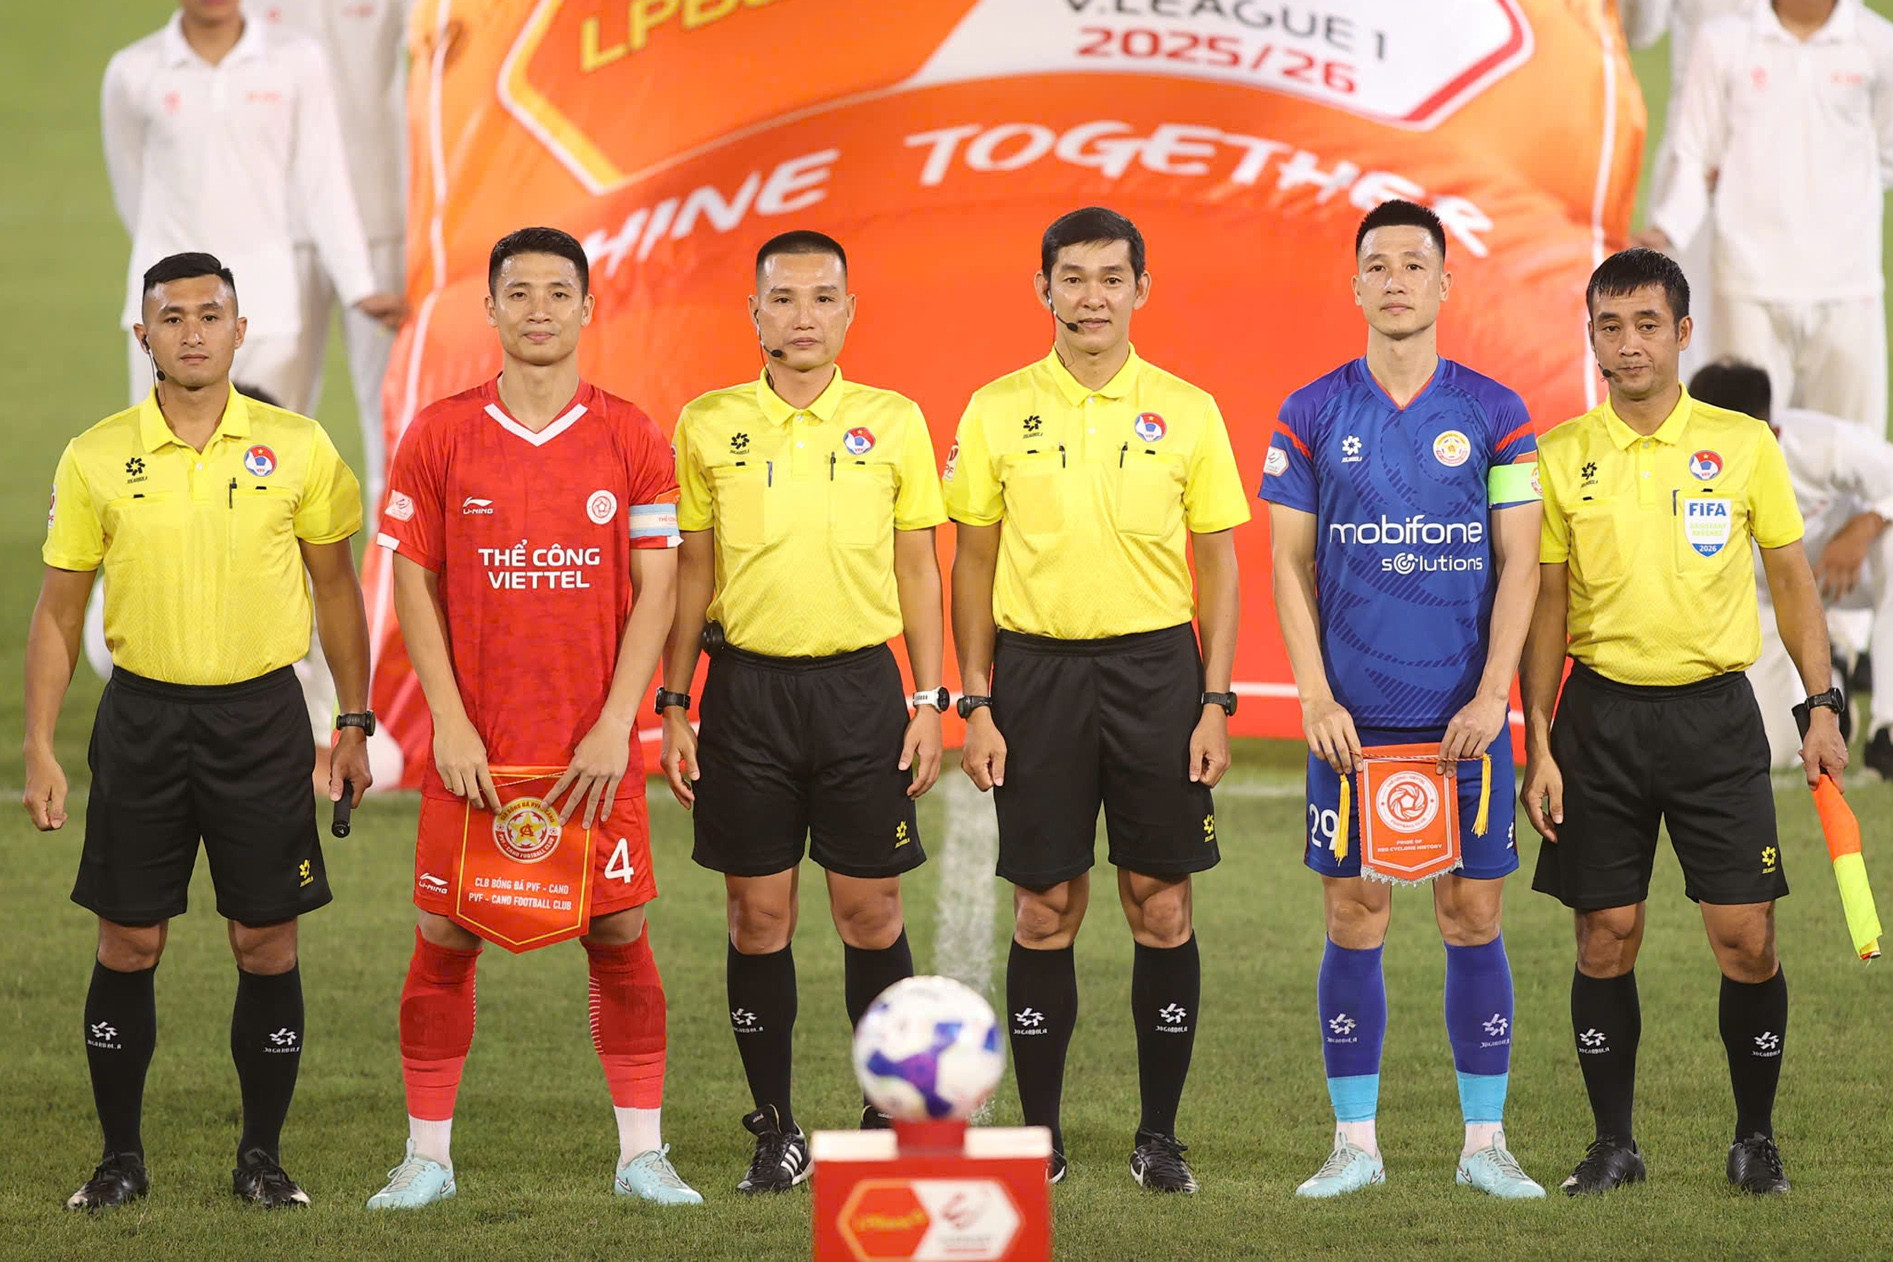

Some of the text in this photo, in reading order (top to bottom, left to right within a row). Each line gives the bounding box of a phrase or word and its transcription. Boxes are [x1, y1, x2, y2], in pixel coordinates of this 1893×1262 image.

[1076, 27, 1356, 94] 2025/26
[583, 120, 1493, 280] HINE TOGETHER
[1689, 503, 1727, 516] FIFA
[1330, 514, 1483, 544] mobifone
[478, 539, 600, 567] THỂ CÔNG
[488, 571, 591, 589] VIETTEL
[1309, 803, 1339, 850] 29
[604, 837, 635, 884] 4
[475, 877, 489, 887] CLB
[491, 877, 512, 890] BÓNG
[526, 882, 541, 891] PVF
[468, 892, 483, 902] PVF
[513, 898, 551, 909] FOOTBALL
[553, 899, 572, 911] CLUB
